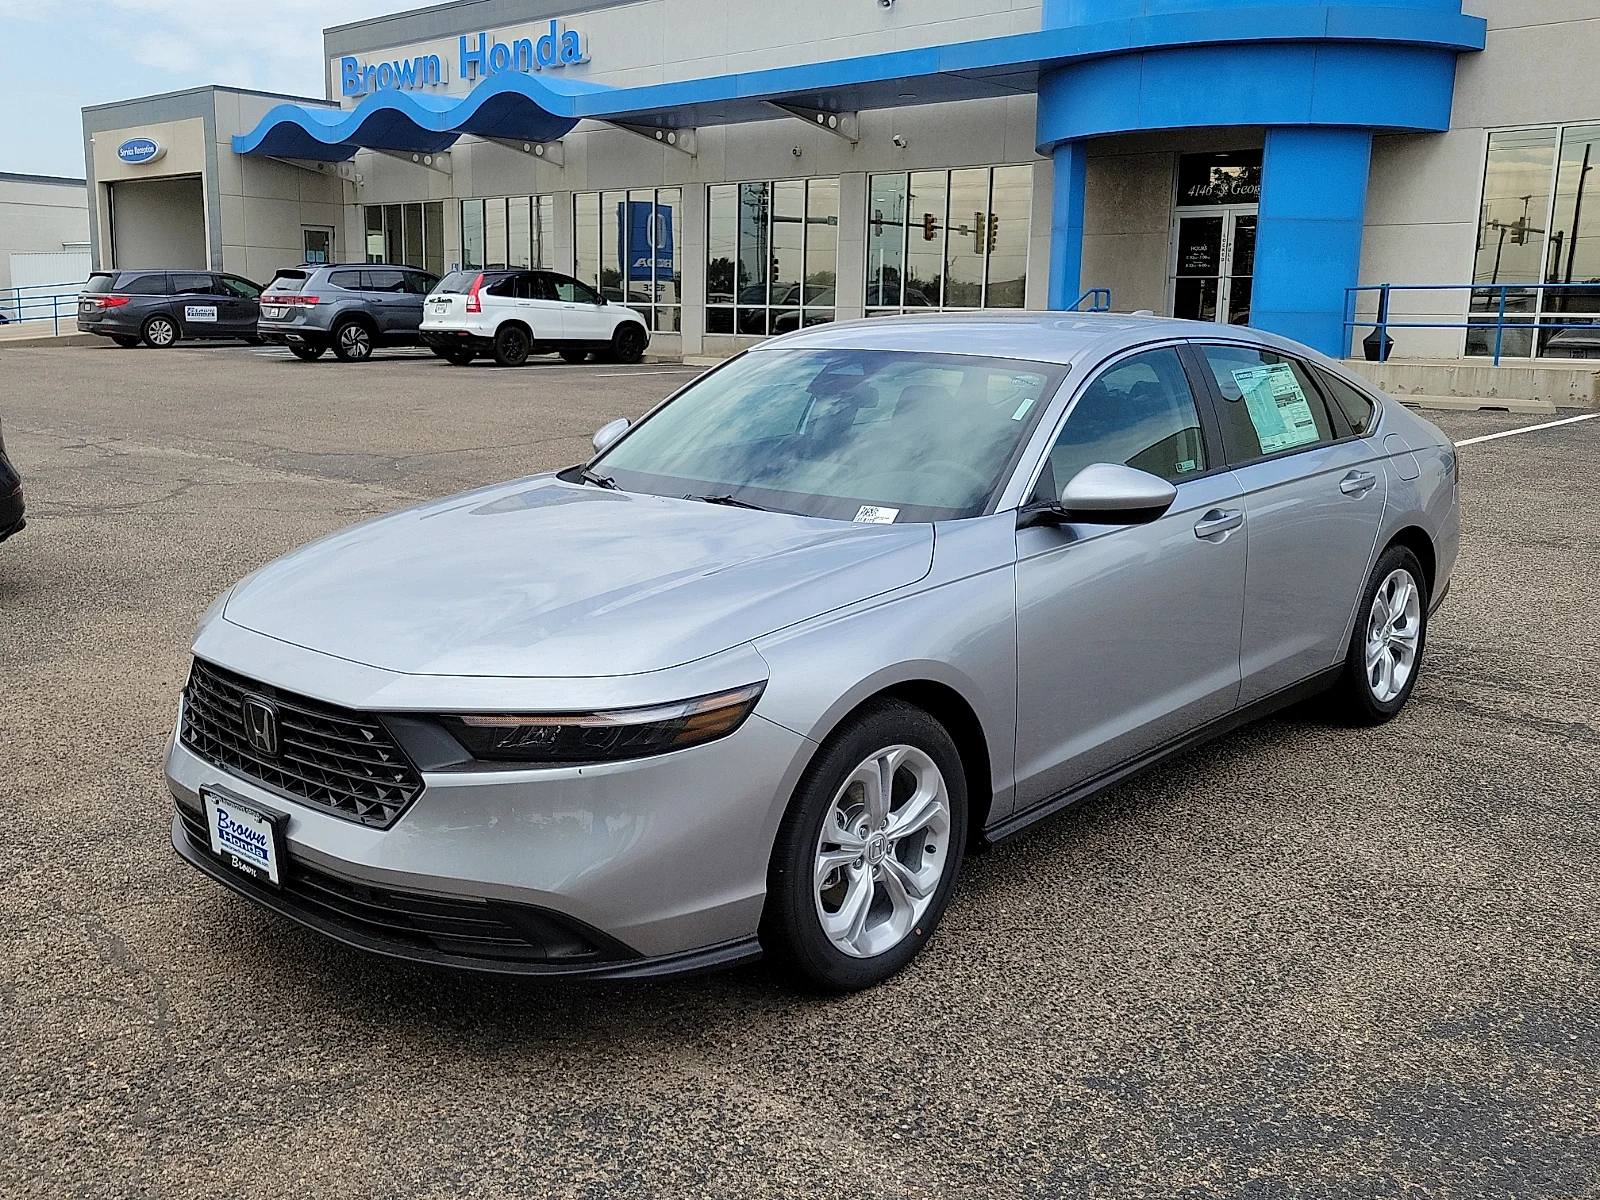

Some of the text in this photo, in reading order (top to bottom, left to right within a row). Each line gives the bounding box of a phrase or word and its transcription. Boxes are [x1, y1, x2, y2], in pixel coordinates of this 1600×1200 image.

[341, 19, 583, 97] Brown Honda
[120, 145, 154, 157] Service Reception
[1188, 184, 1213, 197] 4146
[216, 807, 267, 846] Brown
[223, 829, 264, 858] Honda
[231, 854, 258, 878] Brown
